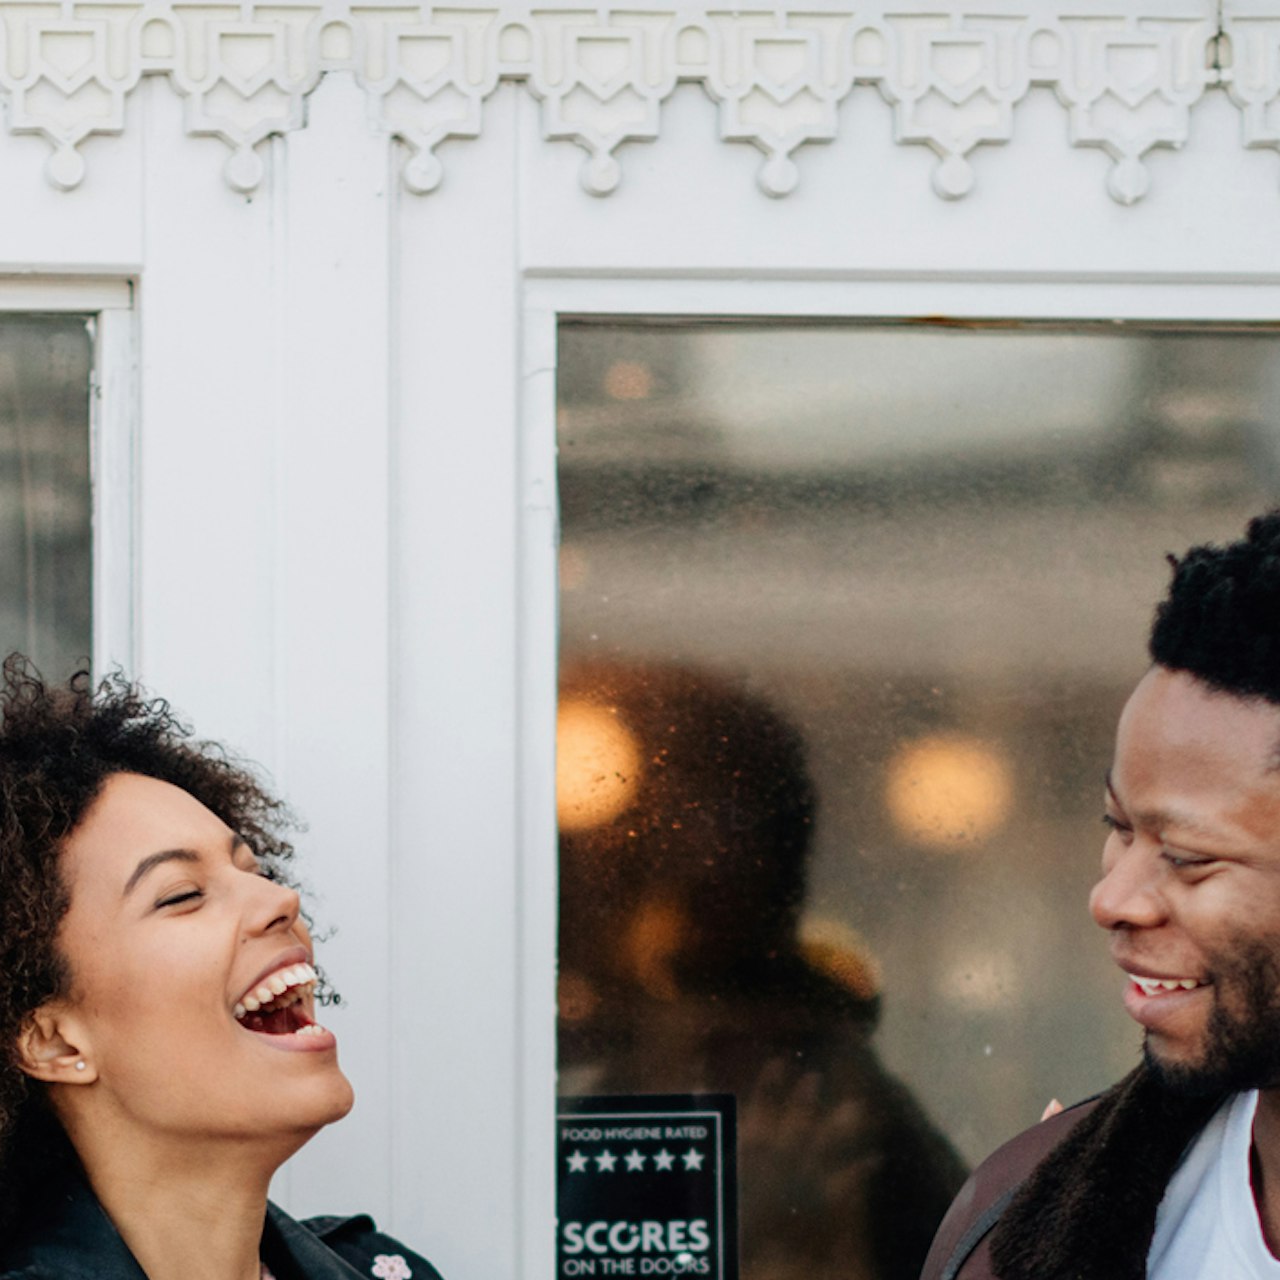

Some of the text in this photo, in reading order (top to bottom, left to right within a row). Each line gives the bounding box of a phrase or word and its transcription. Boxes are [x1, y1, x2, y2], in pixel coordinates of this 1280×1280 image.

[562, 1126, 708, 1141] FOOD HYGIENE RATED
[563, 1219, 710, 1254] SCORES
[563, 1256, 710, 1275] ON THE DOORS
